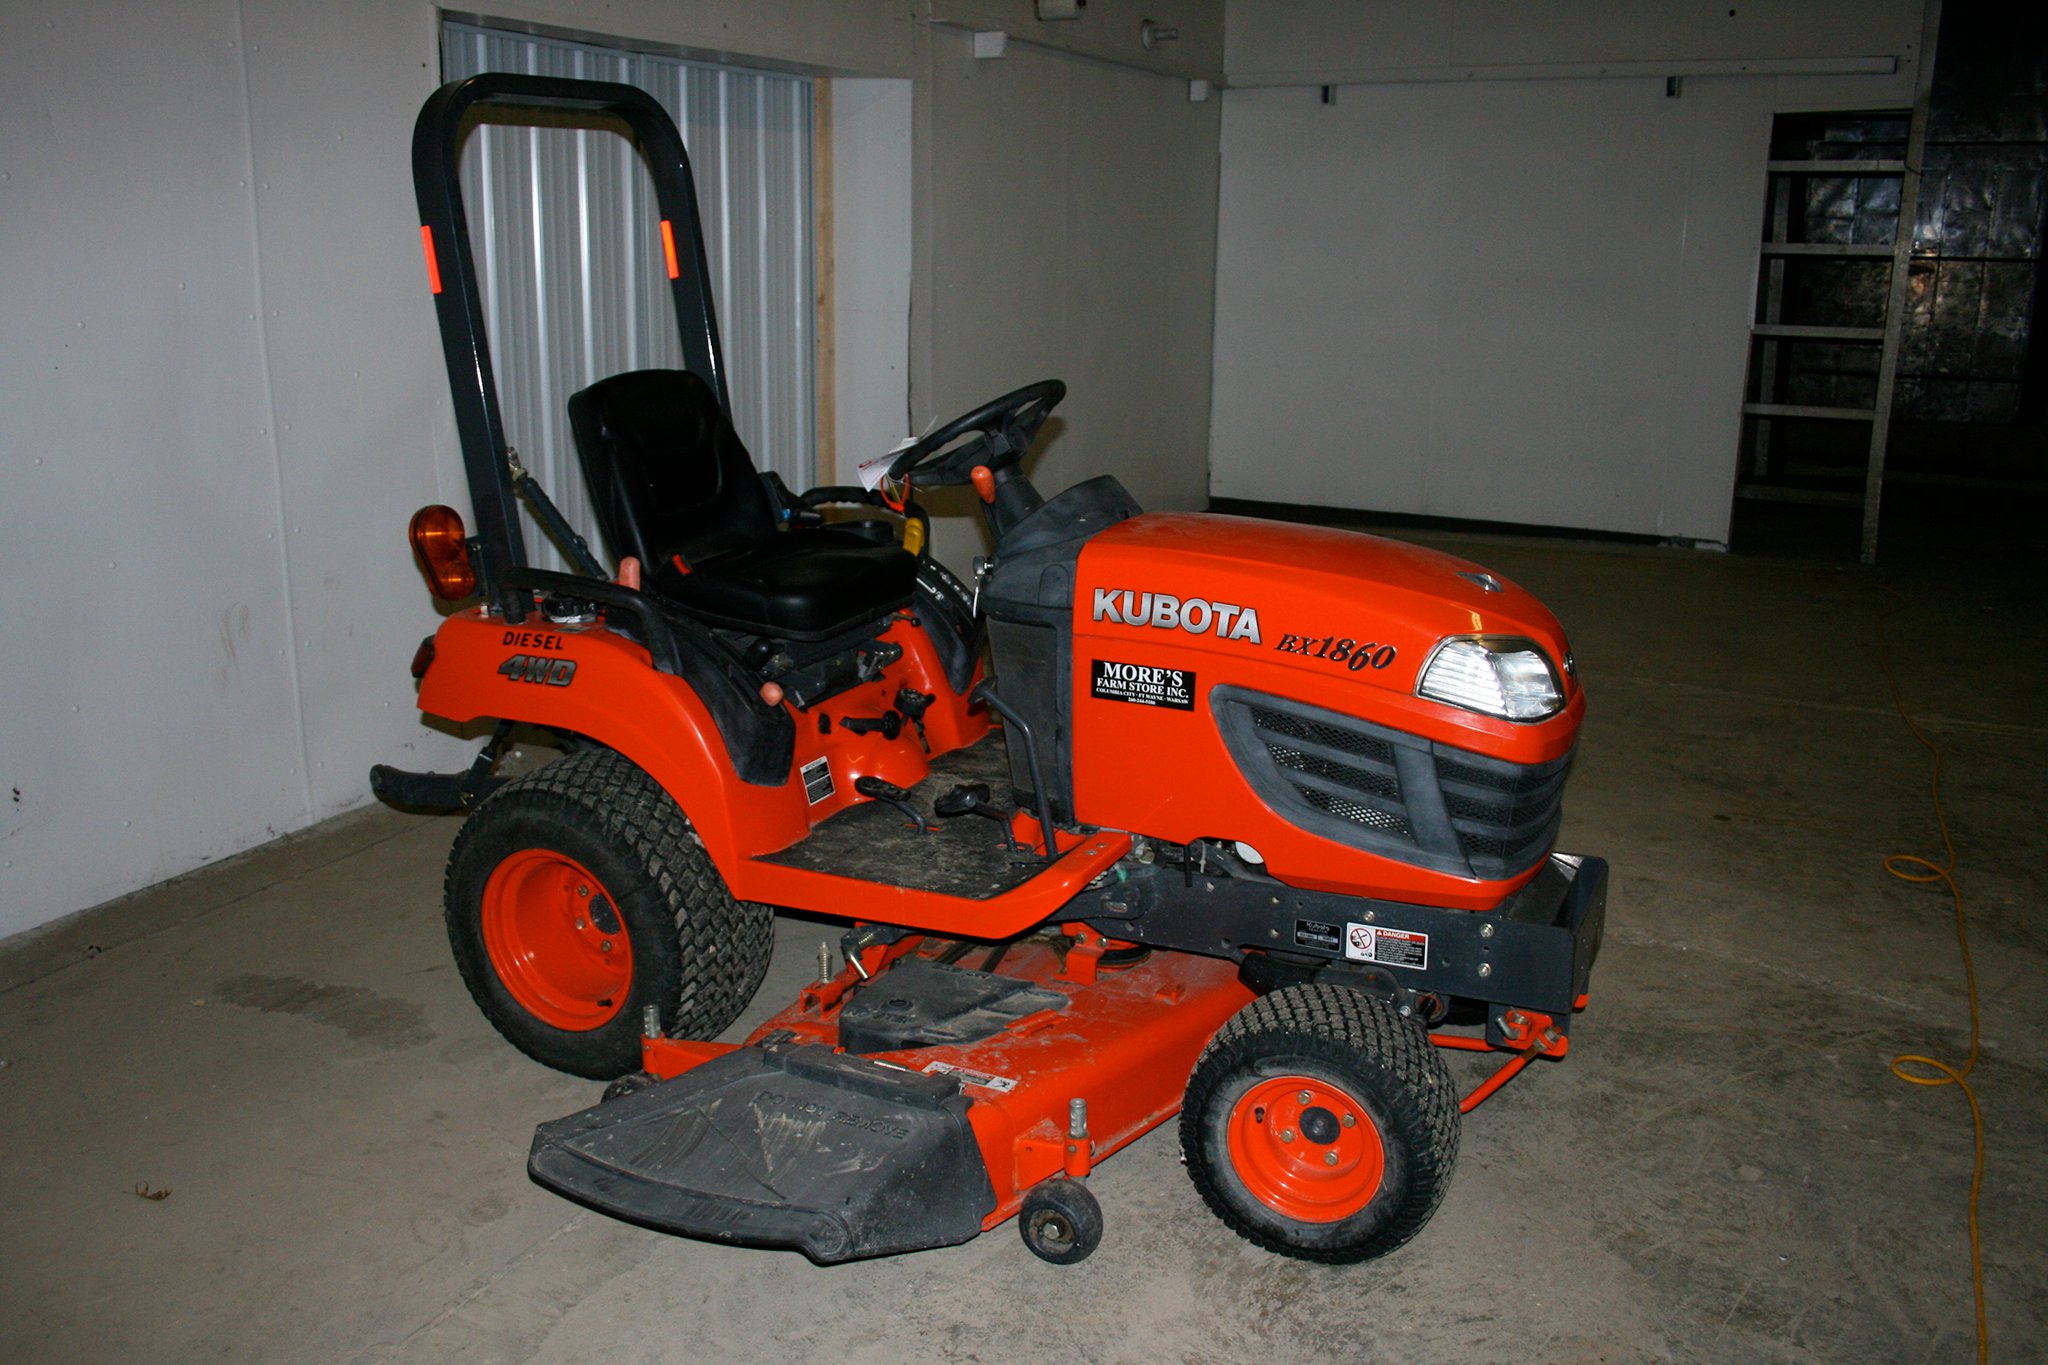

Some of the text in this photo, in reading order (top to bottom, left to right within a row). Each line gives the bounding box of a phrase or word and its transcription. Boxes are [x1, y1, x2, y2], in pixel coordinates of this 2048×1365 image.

[1093, 588, 1262, 644] KUBOTA
[502, 631, 563, 650] DIESEL
[1275, 633, 1397, 671] BX1860
[497, 654, 577, 687] 4WD
[1103, 662, 1183, 687] MORE'S
[1096, 687, 1122, 696] COLUMBIA
[1166, 696, 1189, 704] WARSAW
[1097, 677, 1189, 699] FARM STORE INC.
[1383, 930, 1410, 940] DANGER
[758, 1090, 909, 1139] DO NOT REMOVE
